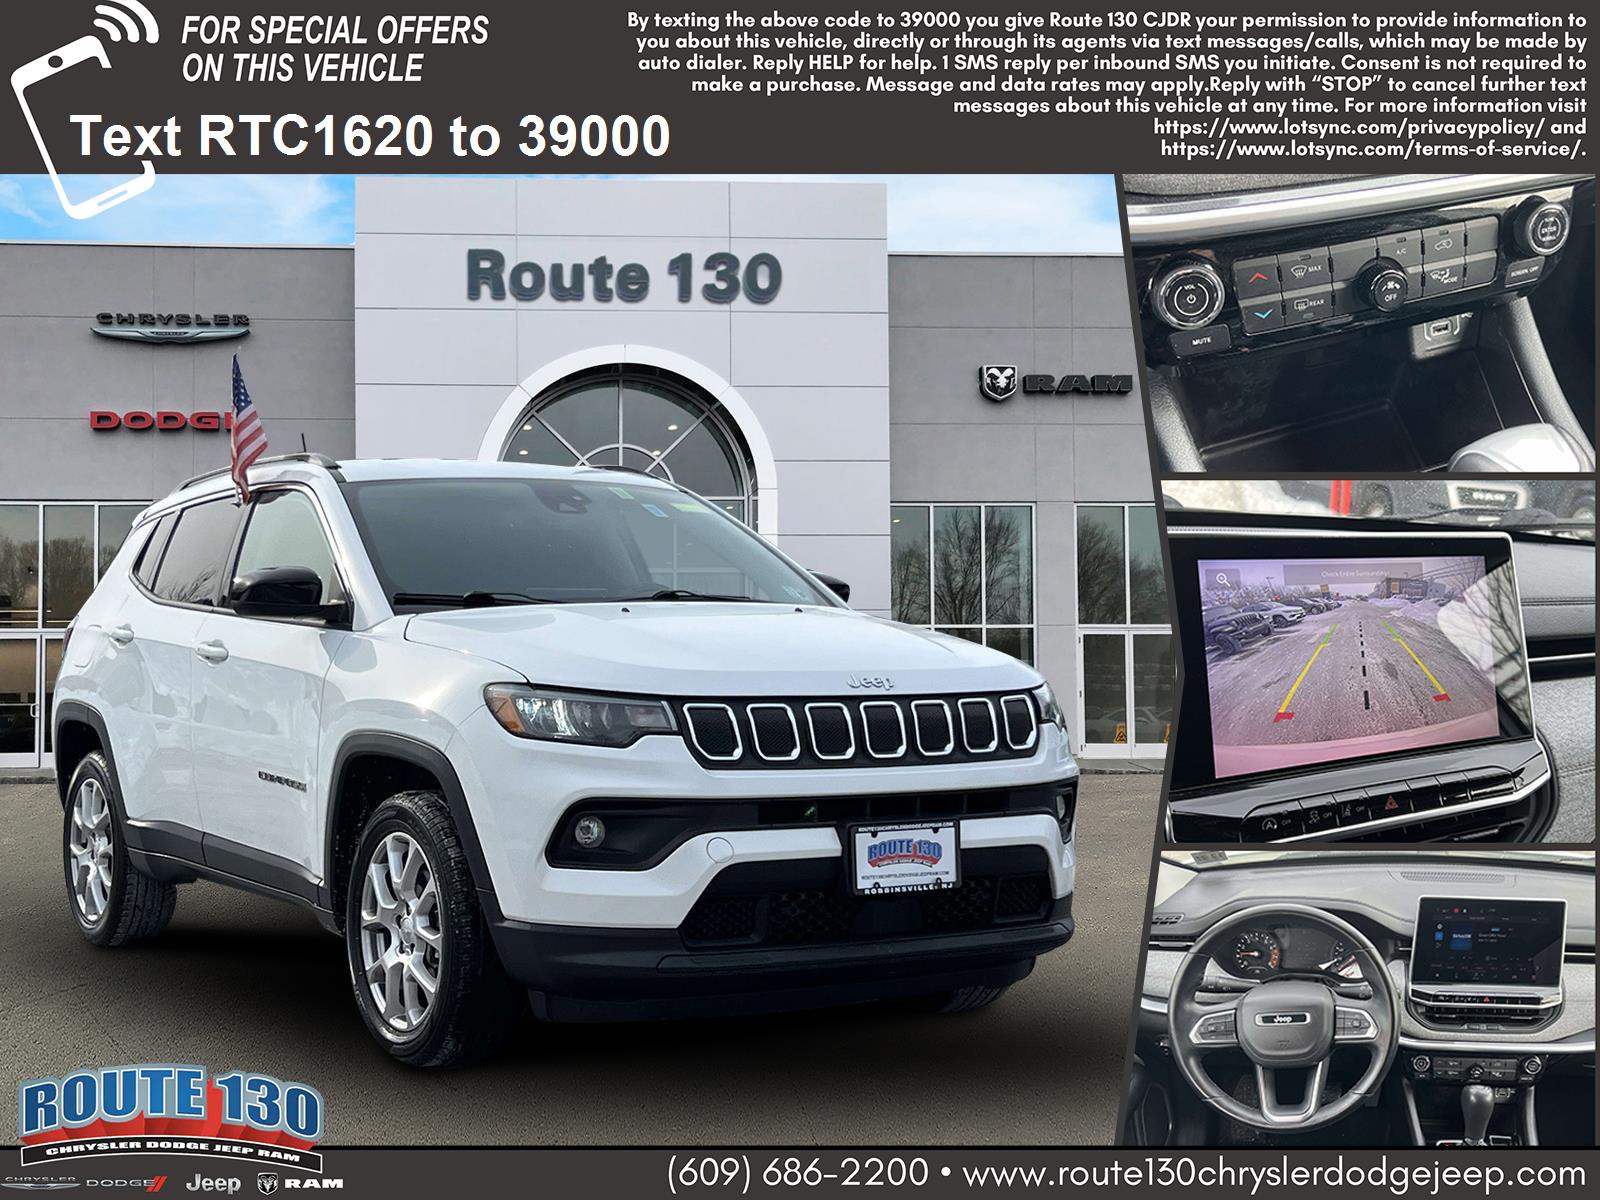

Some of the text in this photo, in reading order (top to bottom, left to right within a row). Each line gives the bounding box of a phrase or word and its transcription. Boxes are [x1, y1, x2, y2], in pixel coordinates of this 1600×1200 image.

[1308, 264, 1322, 272] MAX
[467, 248, 783, 304] Route 130
[1309, 299, 1325, 307] REAR
[1384, 294, 1398, 302] OFF
[96, 313, 250, 326] CHRYSLER
[1192, 337, 1212, 346] MUTE
[1023, 374, 1133, 393] RAM
[846, 671, 895, 691] Jeep
[868, 839, 942, 860] ROUTE 130
